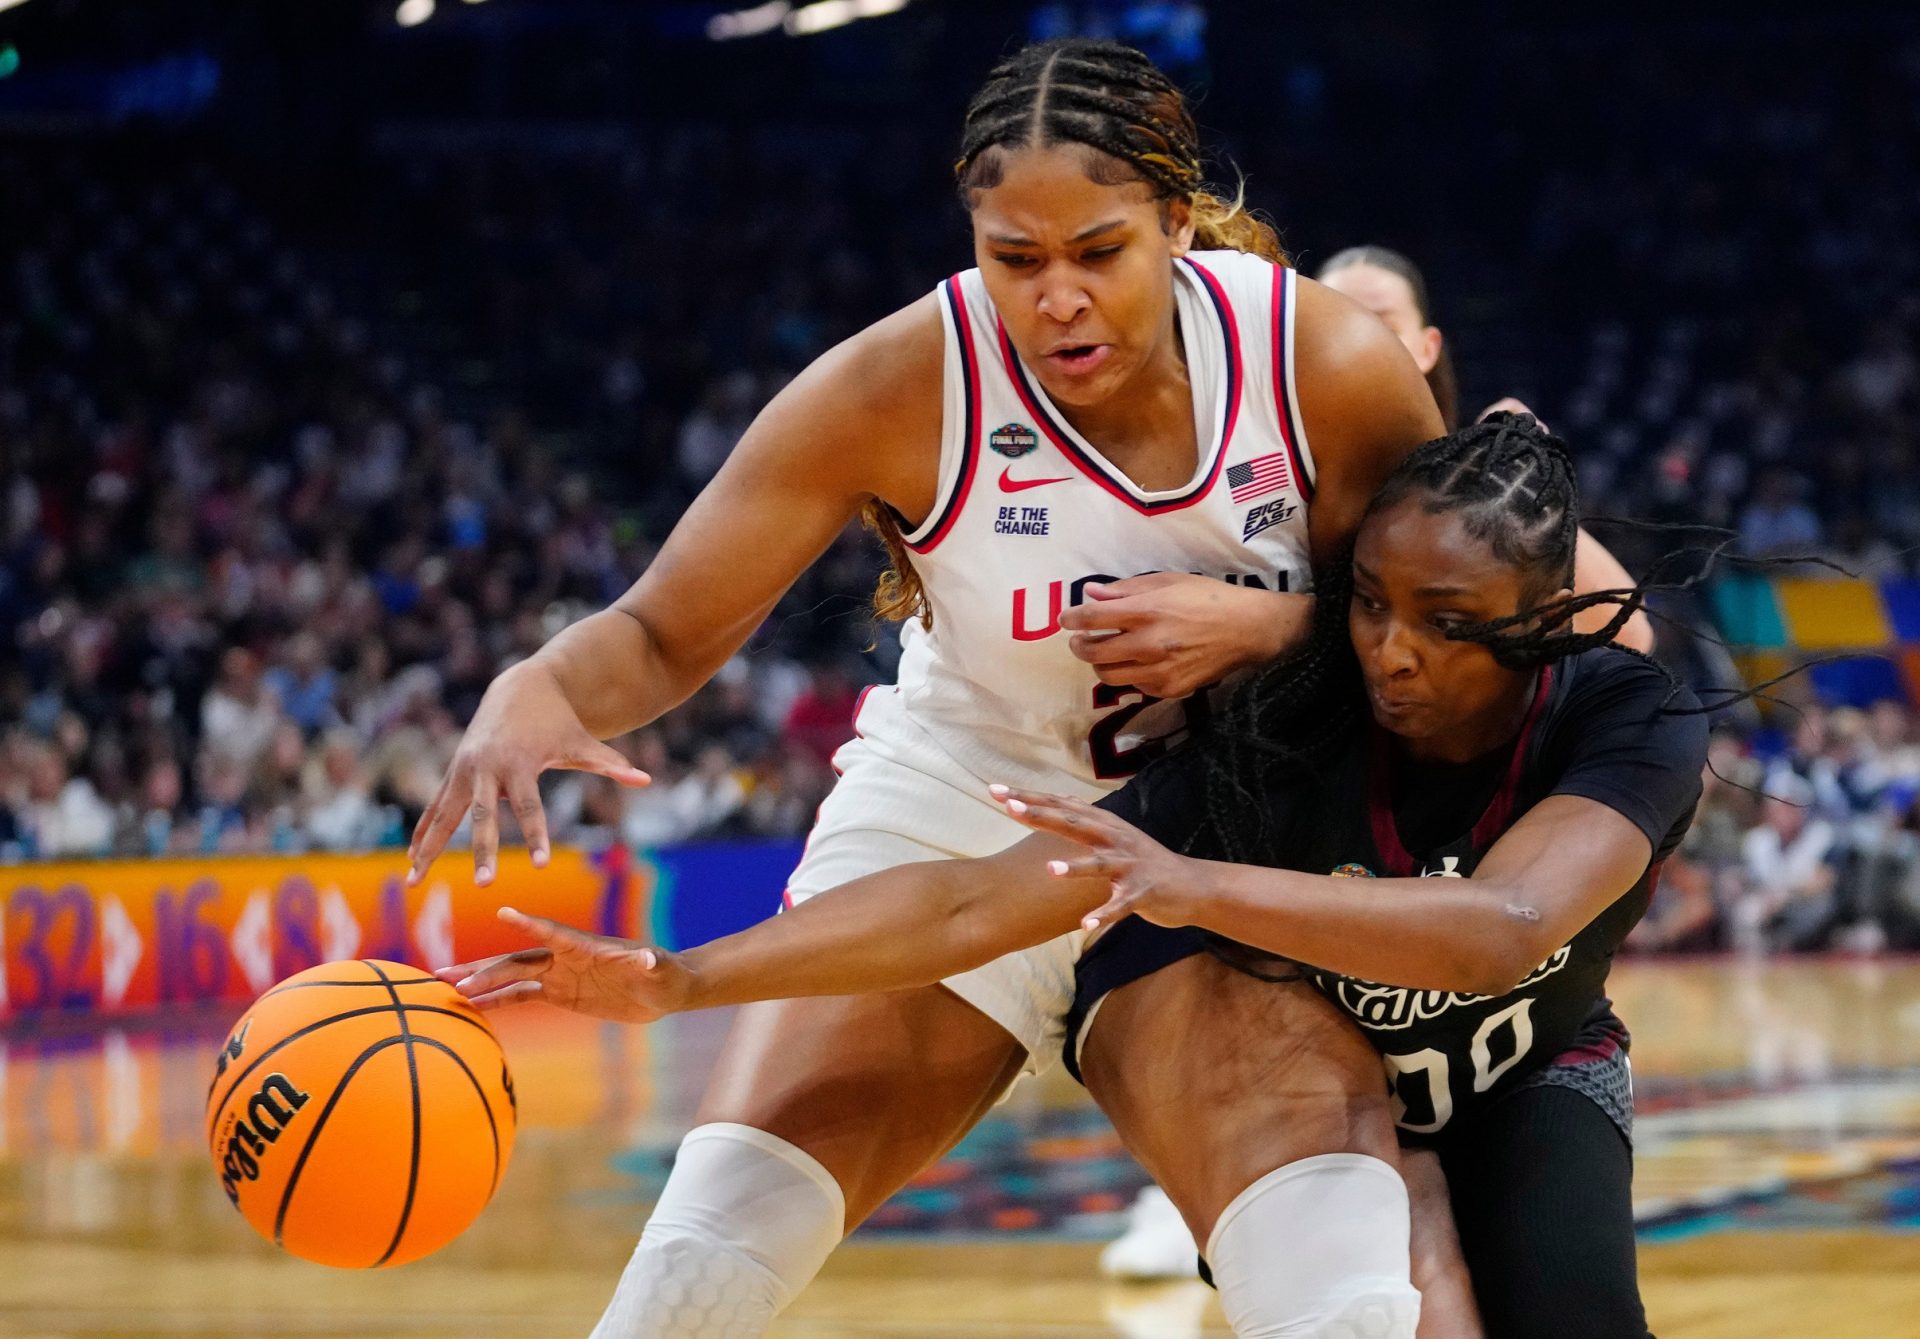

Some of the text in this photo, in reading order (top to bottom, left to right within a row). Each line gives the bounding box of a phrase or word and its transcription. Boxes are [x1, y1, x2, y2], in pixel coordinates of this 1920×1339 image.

[998, 506, 1048, 521] BE THE
[1243, 505, 1298, 536] EAST
[1246, 497, 1286, 522] BIG
[994, 520, 1050, 536] CHANGE
[219, 1071, 313, 1212] Wilso
